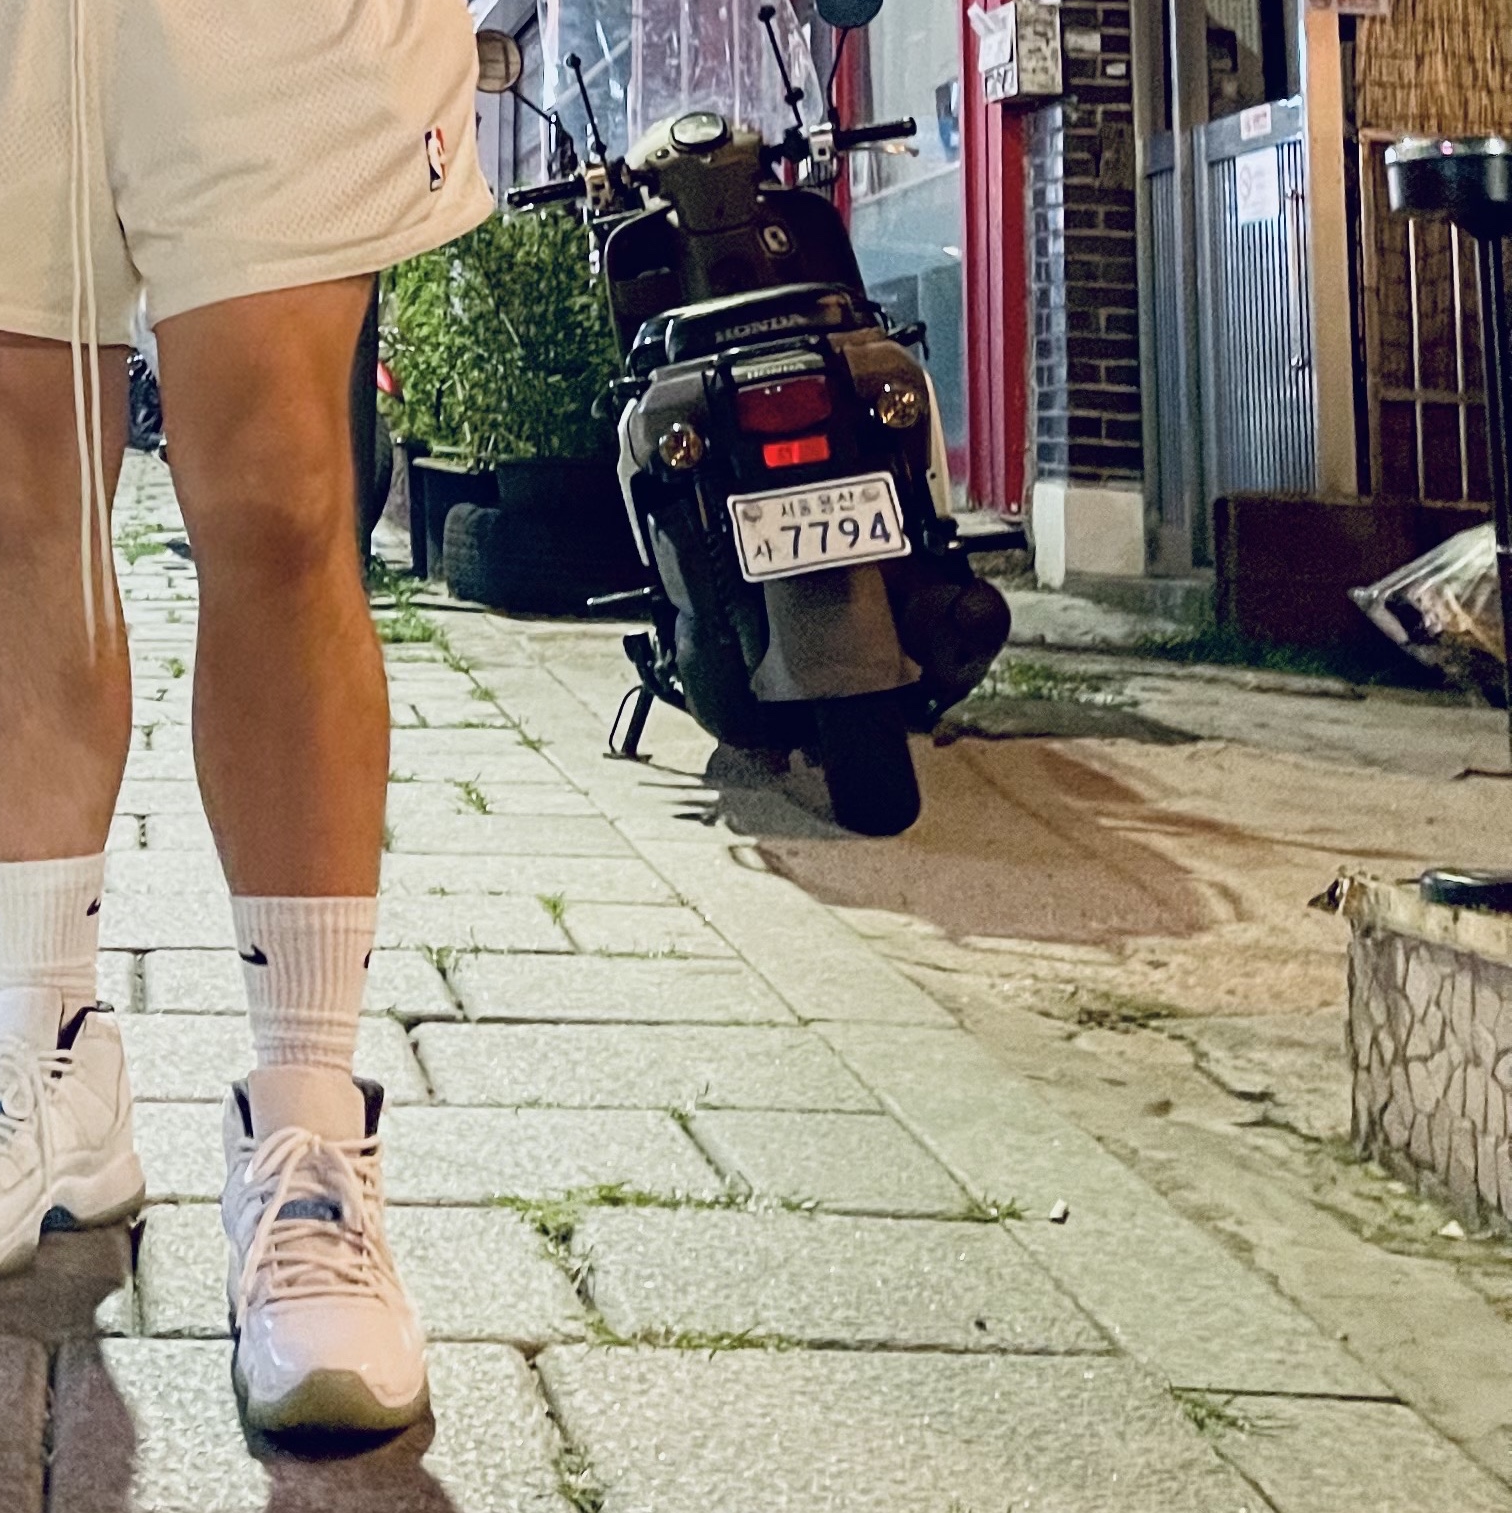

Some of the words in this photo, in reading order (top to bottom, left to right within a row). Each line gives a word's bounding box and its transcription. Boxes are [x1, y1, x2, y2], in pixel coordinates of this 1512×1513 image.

[715, 313, 808, 344] HONDA
[747, 362, 807, 380] HONDA
[754, 540, 772, 562] 사
[780, 511, 890, 559] 7794
